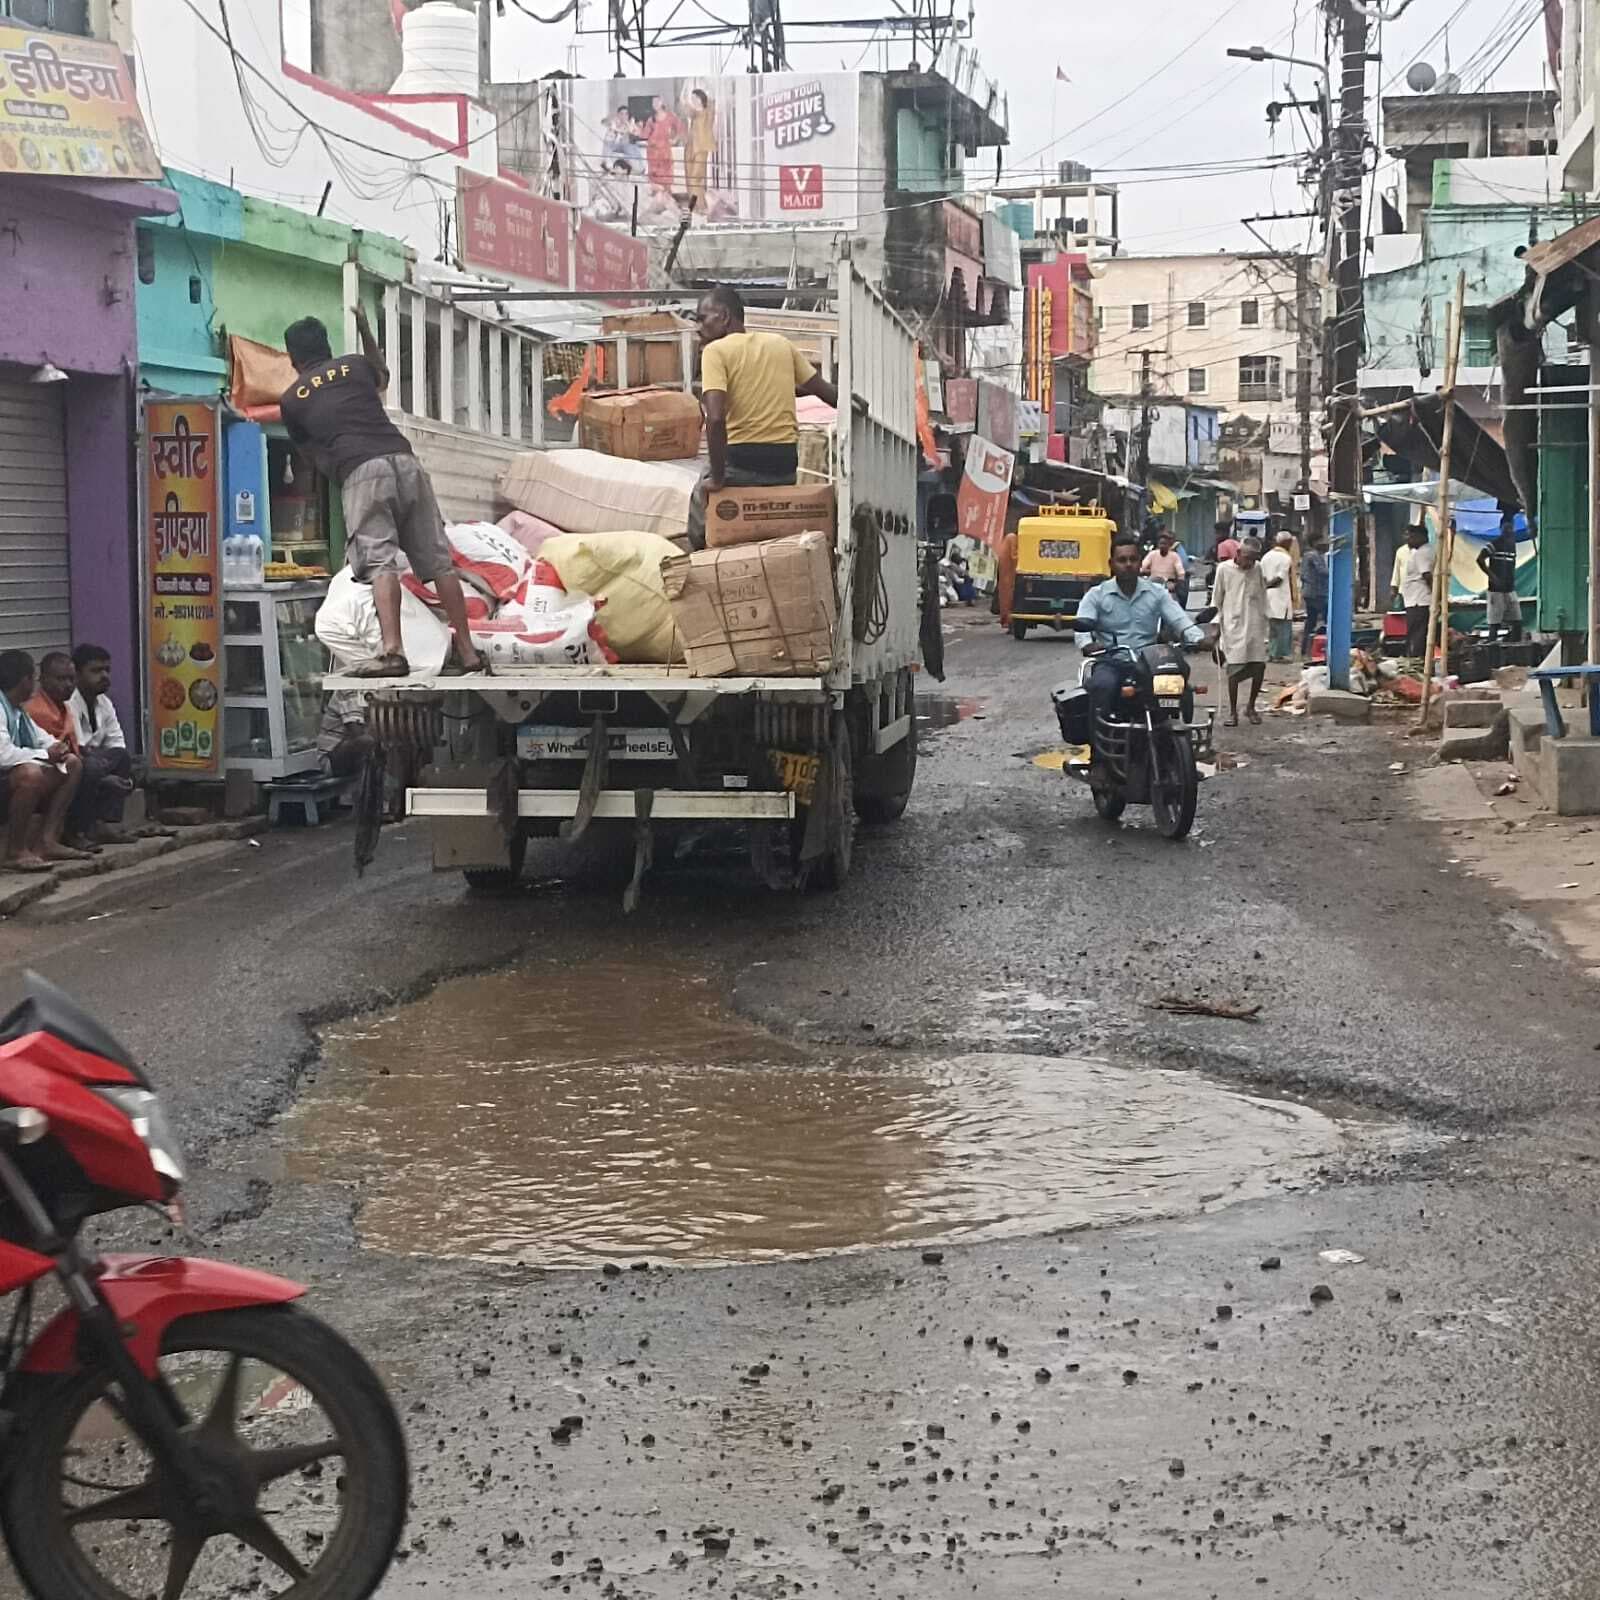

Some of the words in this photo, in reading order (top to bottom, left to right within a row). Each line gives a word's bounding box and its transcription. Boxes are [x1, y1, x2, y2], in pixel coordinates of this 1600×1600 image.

[767, 91, 793, 107] OWN
[794, 81, 821, 100] YOUR
[767, 95, 823, 126] FESTIVE
[777, 118, 813, 146] FITS
[789, 167, 813, 193] V
[783, 194, 820, 208] MART
[296, 365, 350, 398] CRPF
[152, 415, 209, 479] स्वीट
[742, 501, 792, 512] m-star
